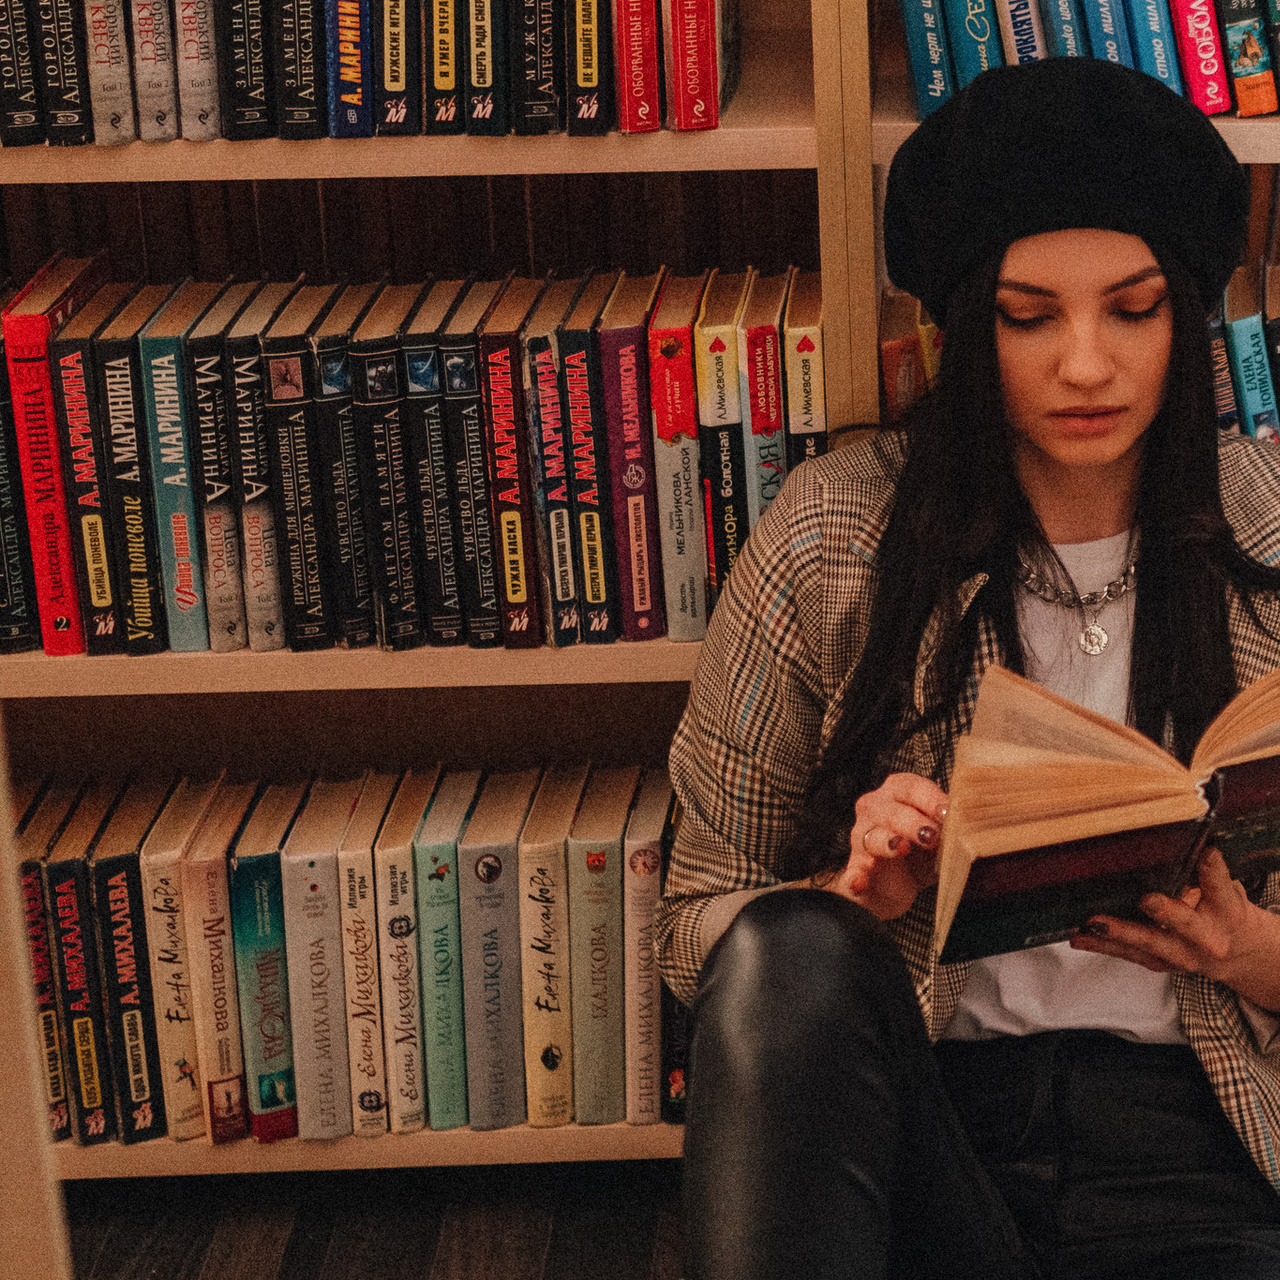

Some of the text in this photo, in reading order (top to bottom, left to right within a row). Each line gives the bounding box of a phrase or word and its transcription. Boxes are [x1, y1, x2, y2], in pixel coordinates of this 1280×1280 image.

[90, 5, 111, 68] КВЕСТ
[231, 3, 247, 88] ЗАМЕНА
[389, 0, 400, 83] МУЖСКИЕ ИГРЫ
[438, 0, 450, 69] УМЕР ВЧЕРА
[581, 32, 593, 68] МЕШАЙТЕ
[628, 12, 645, 97] ОБОРВАННЫЕ
[619, 344, 641, 440] МЕЛЬНИКОВА
[24, 387, 56, 503] МАРИНИНА
[681, 446, 693, 506] ЛАНСКОЙ
[373, 424, 398, 603] ФАНТОМ ПАМЯТИ
[123, 496, 154, 641] Убийца поневоле
[56, 616, 68, 631] 2
[108, 871, 139, 984] МИХАЛЕВА
